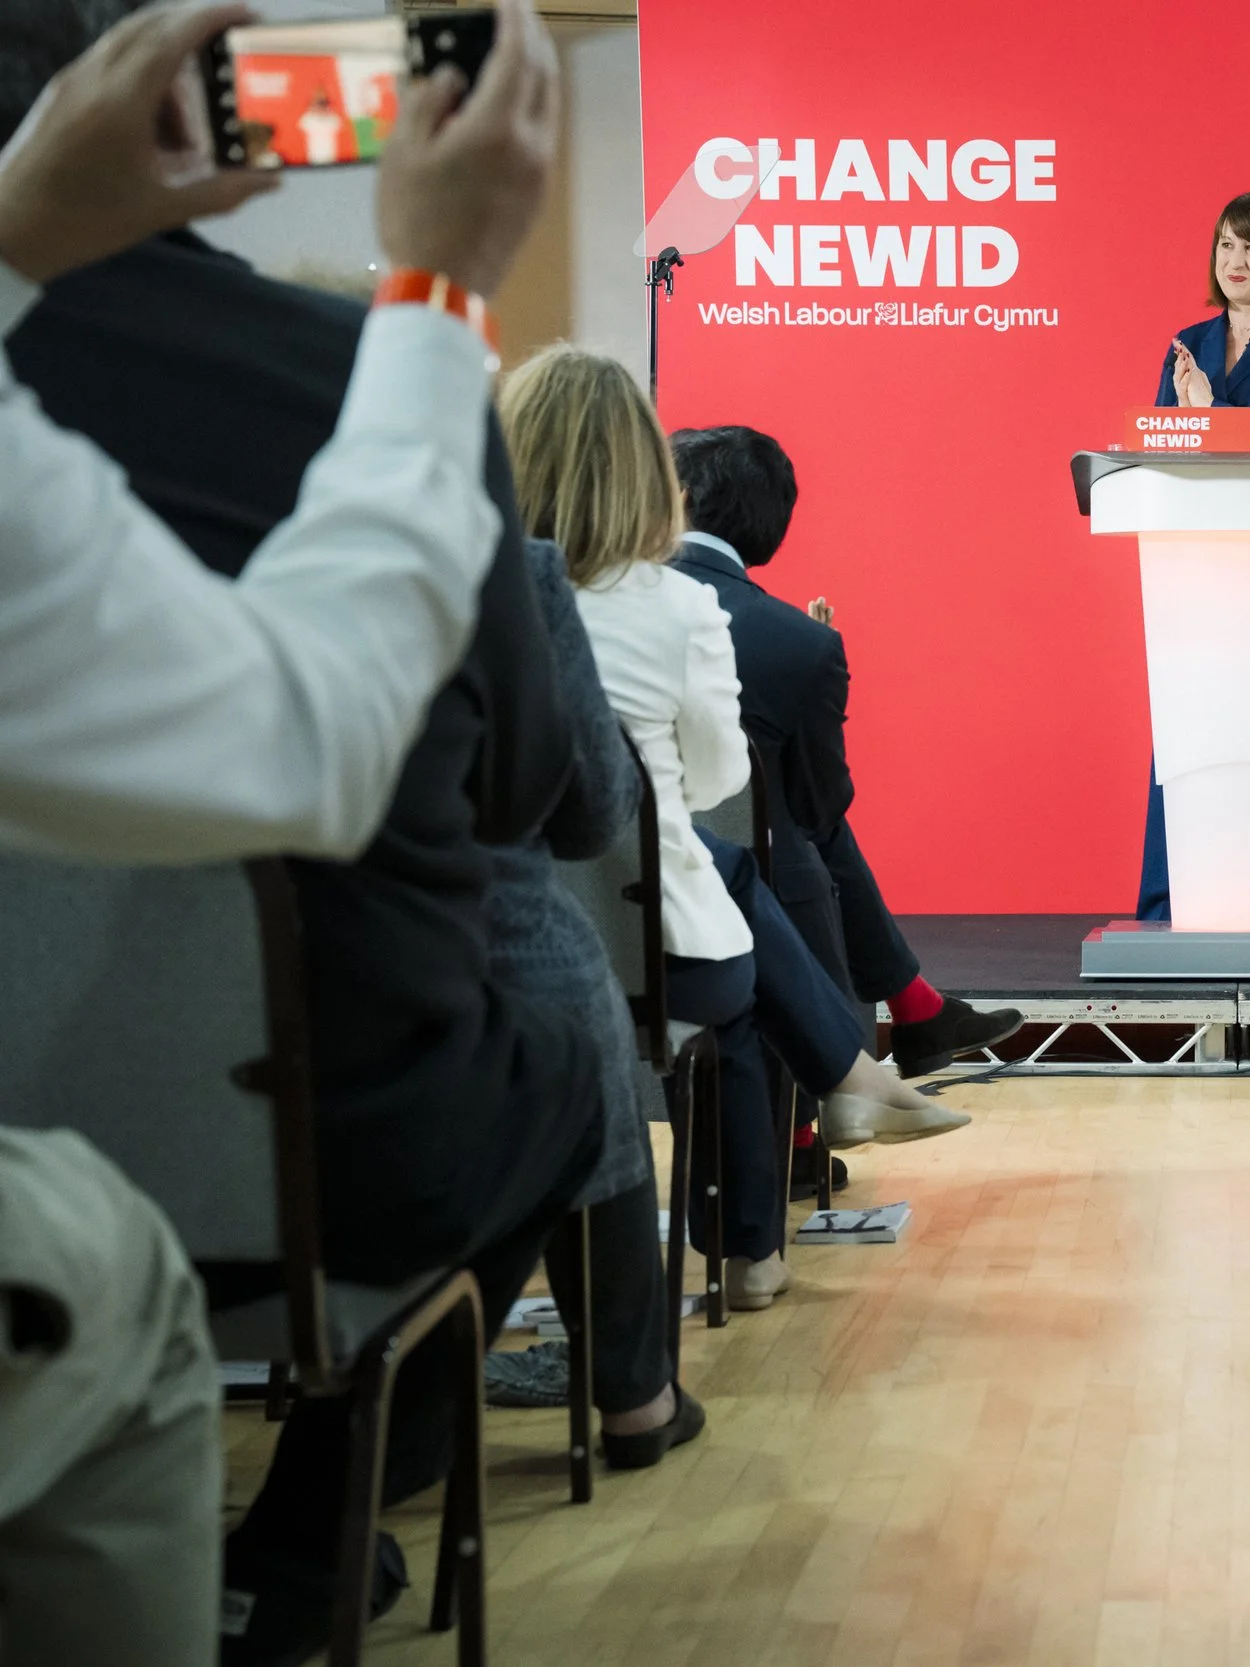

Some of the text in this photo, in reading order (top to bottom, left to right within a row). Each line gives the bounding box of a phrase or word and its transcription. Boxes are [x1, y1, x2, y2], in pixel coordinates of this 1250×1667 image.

[694, 137, 1056, 202] CHANGE
[735, 224, 1019, 287] NEWID
[697, 301, 1059, 331] Welsh Labour Llafur Cymru
[1135, 416, 1210, 431] CHANGE
[1143, 433, 1202, 448] NEWID
